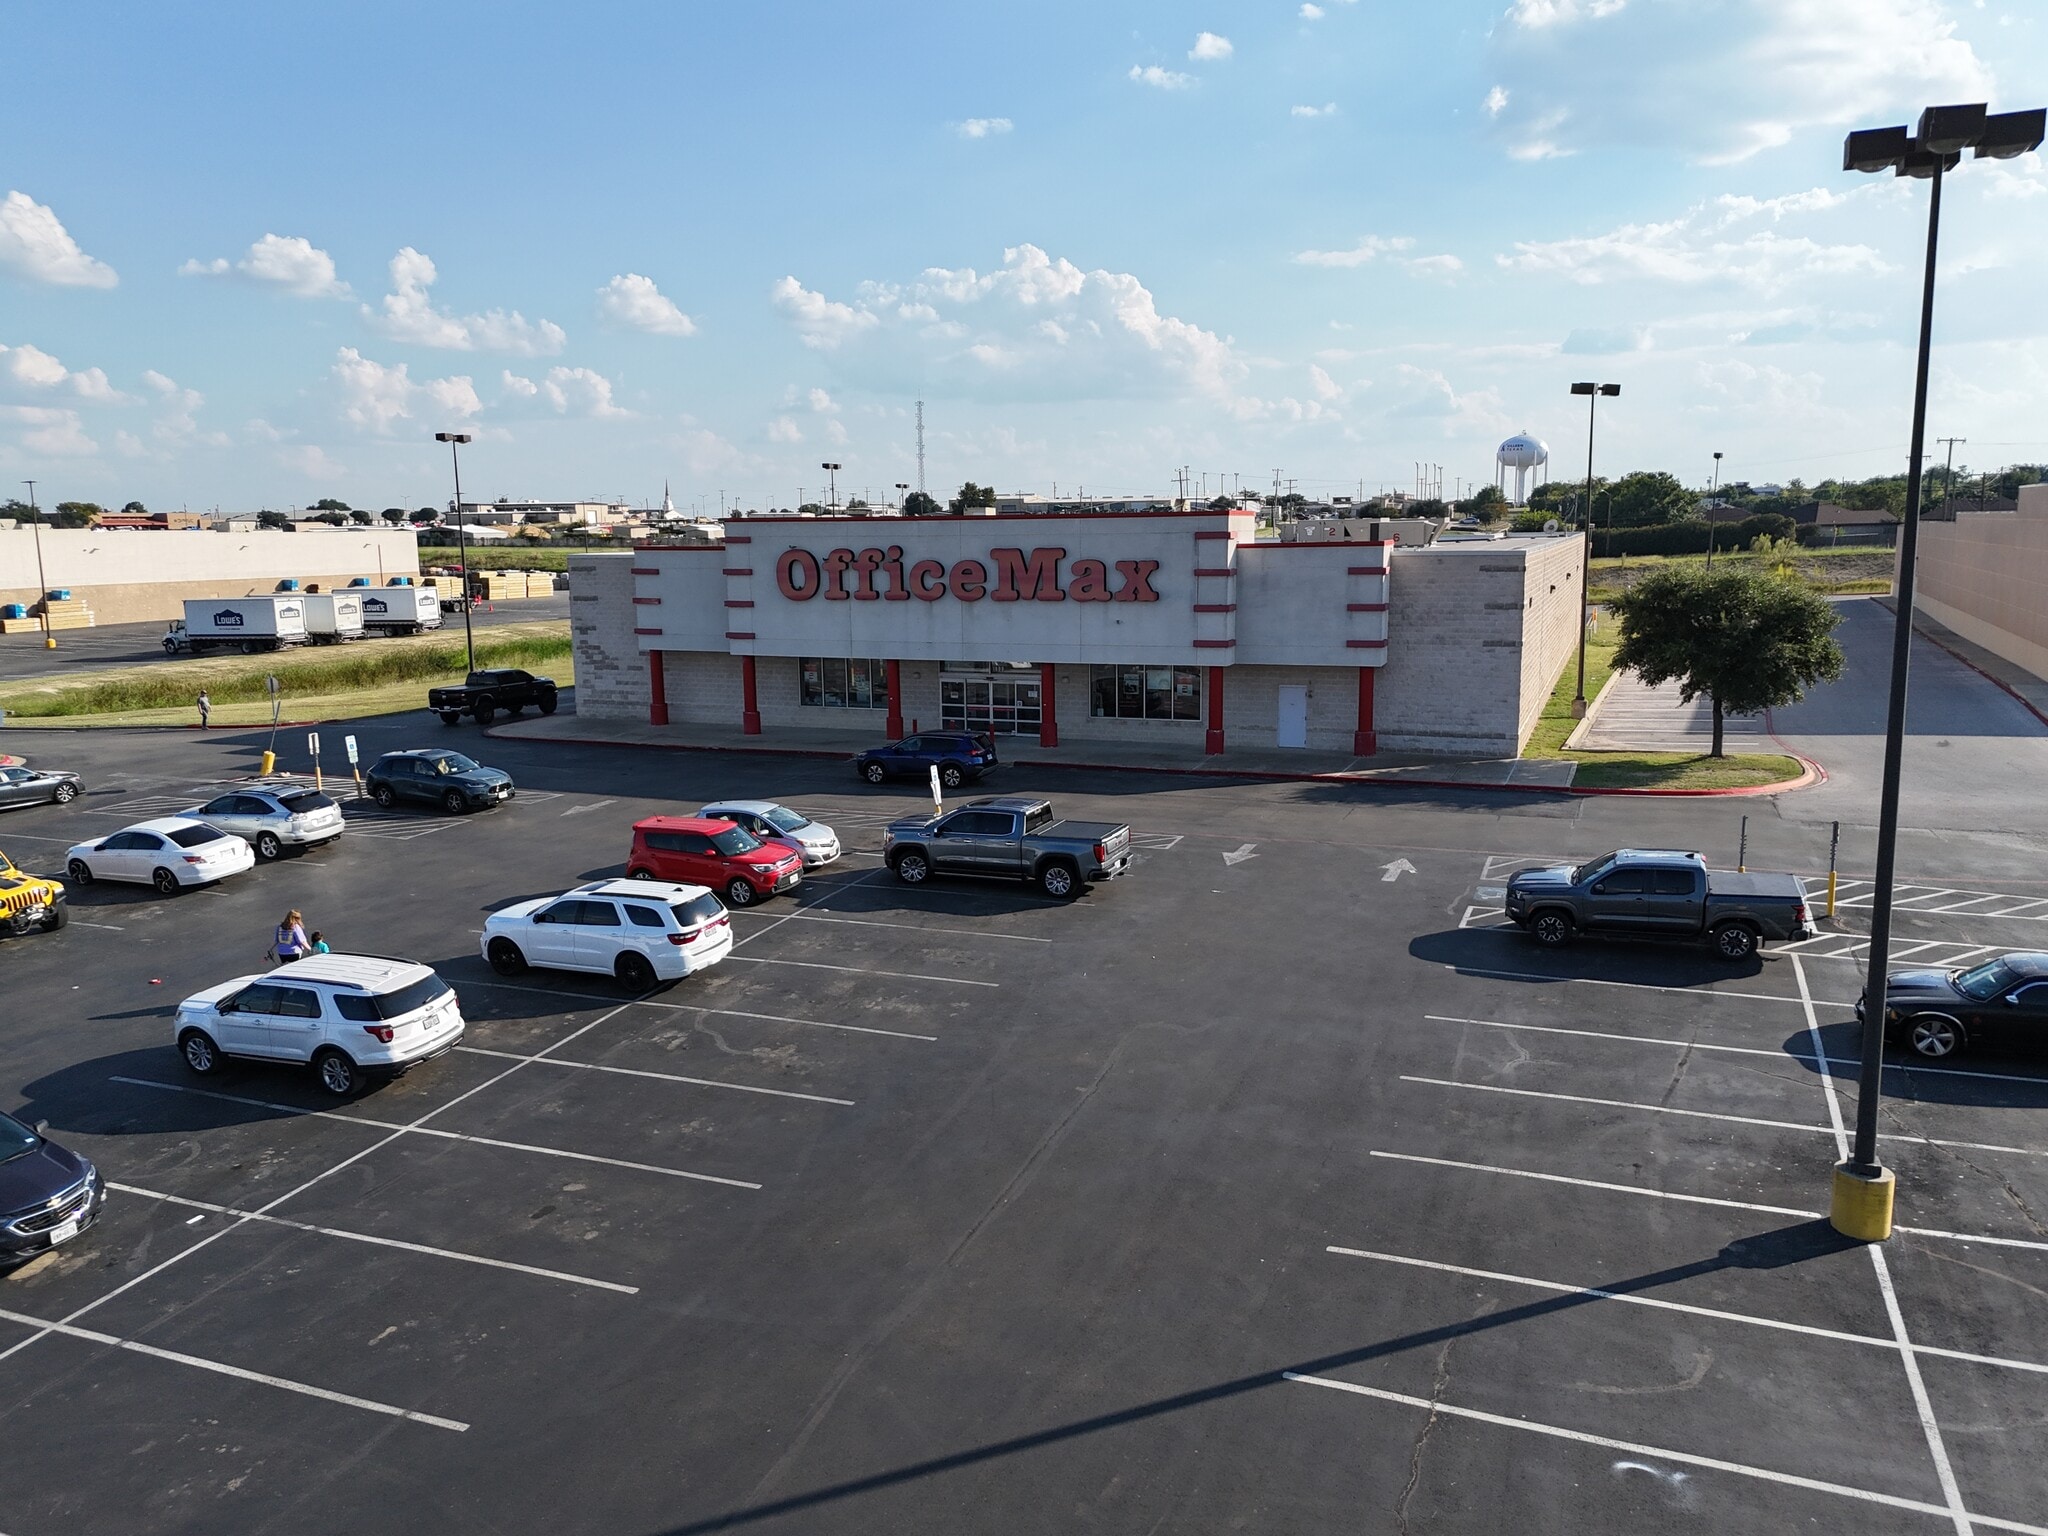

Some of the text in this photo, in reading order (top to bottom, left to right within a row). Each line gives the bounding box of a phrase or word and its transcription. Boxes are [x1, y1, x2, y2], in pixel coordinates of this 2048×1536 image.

[1328, 527, 1336, 536] 2
[1393, 532, 1400, 542] 6
[775, 545, 1160, 603] OfficeMax
[216, 615, 241, 625] LOWE'S
